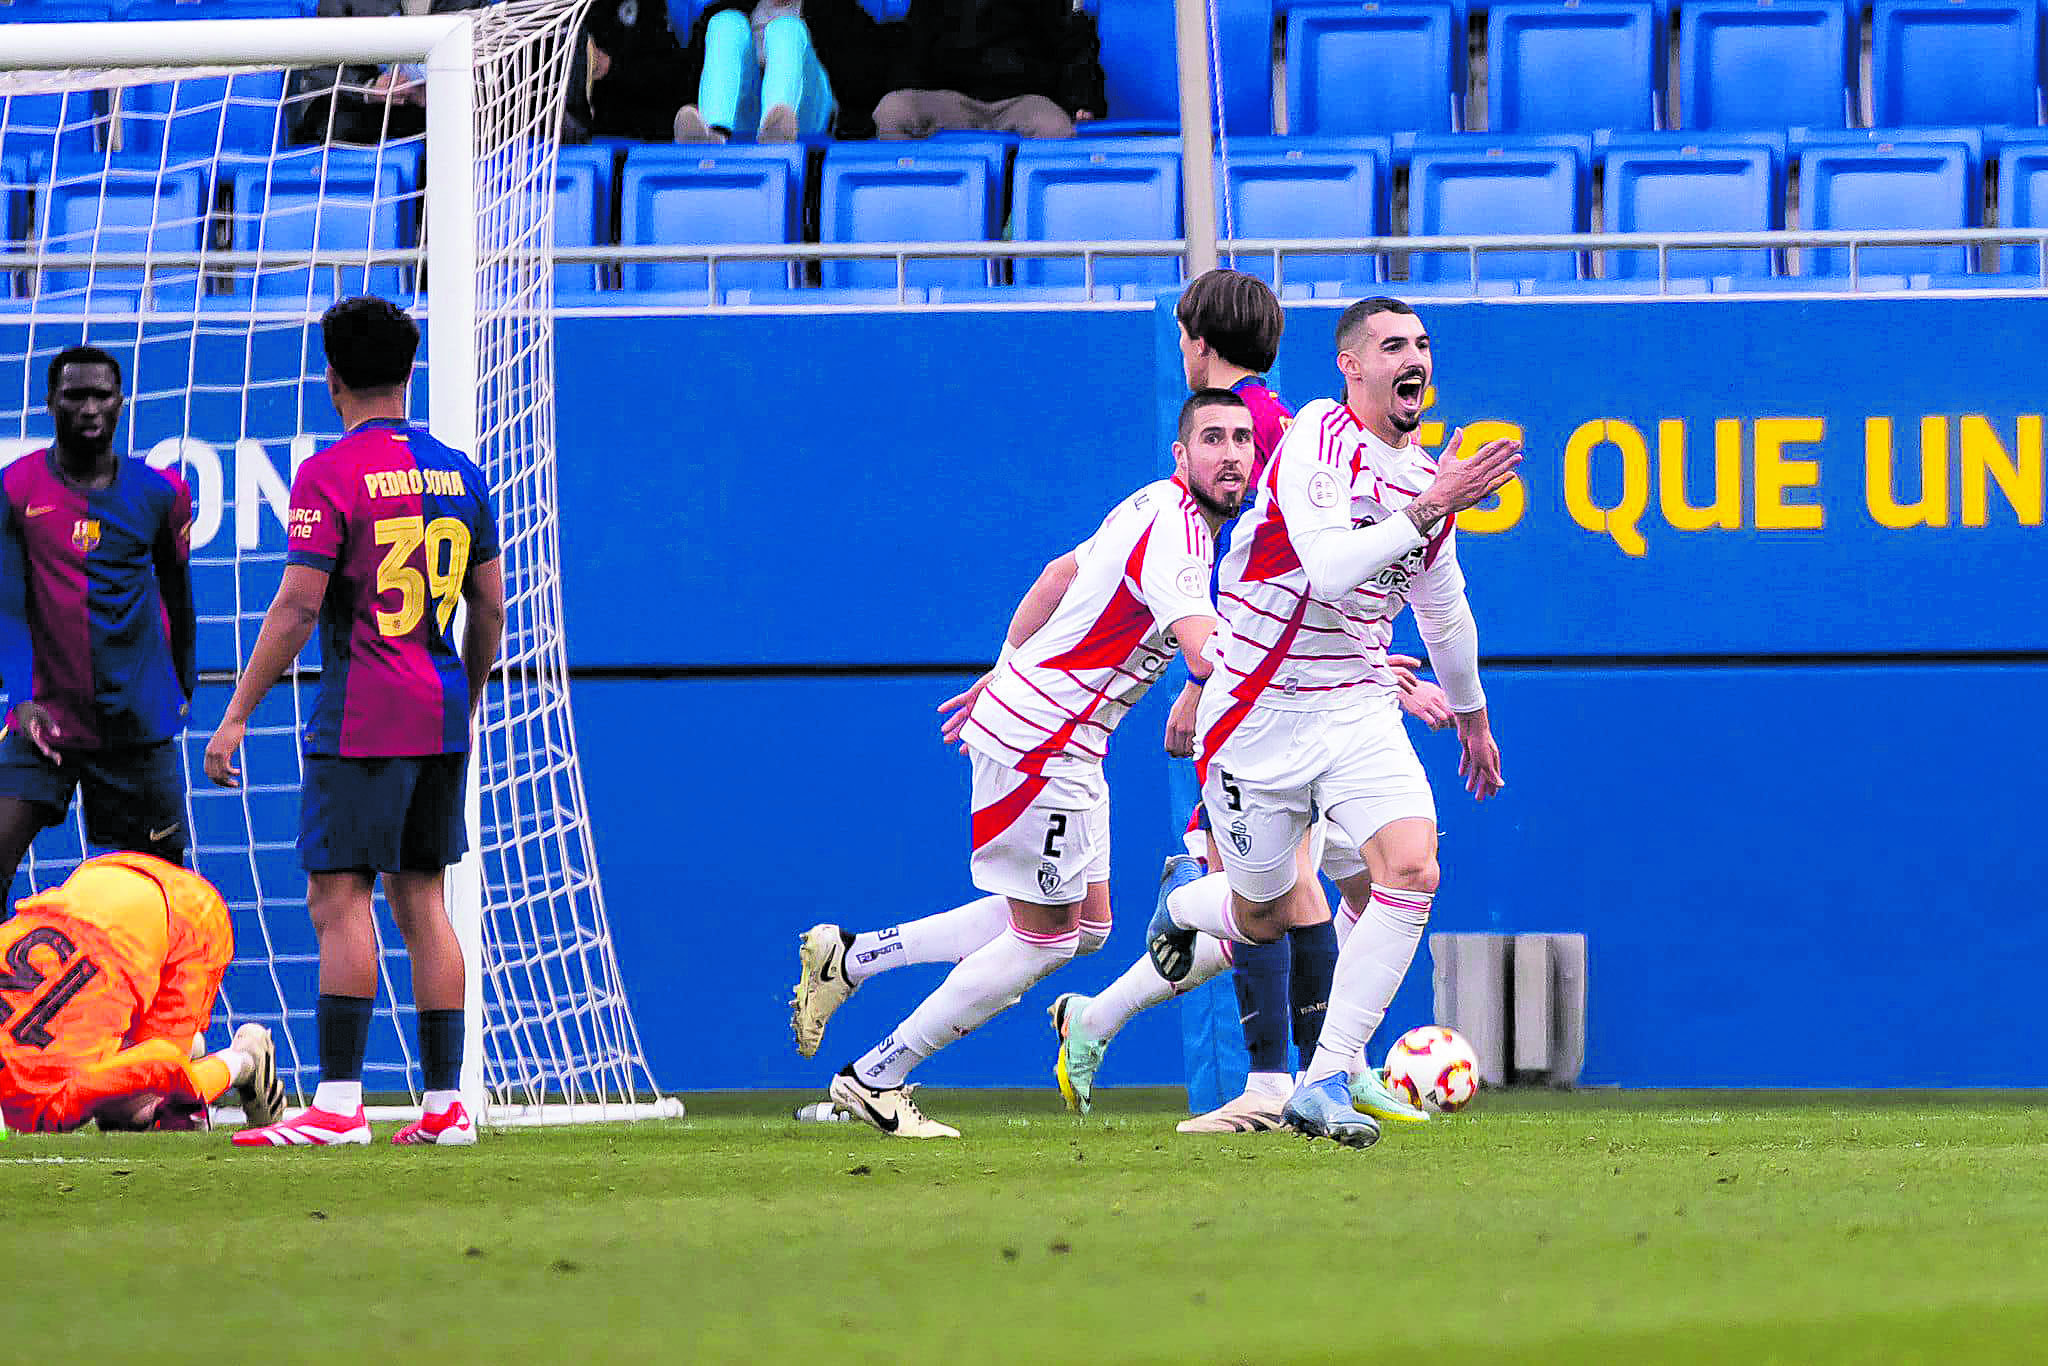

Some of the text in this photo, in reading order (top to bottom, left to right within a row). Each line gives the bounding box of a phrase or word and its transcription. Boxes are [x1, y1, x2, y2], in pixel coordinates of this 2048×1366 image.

[364, 469, 424, 498] PEDRO
[1564, 417, 1824, 557] QUE
[1865, 415, 2043, 529] UN
[374, 515, 472, 637] 39
[1221, 768, 1243, 812] 5
[1042, 813, 1067, 858] 2
